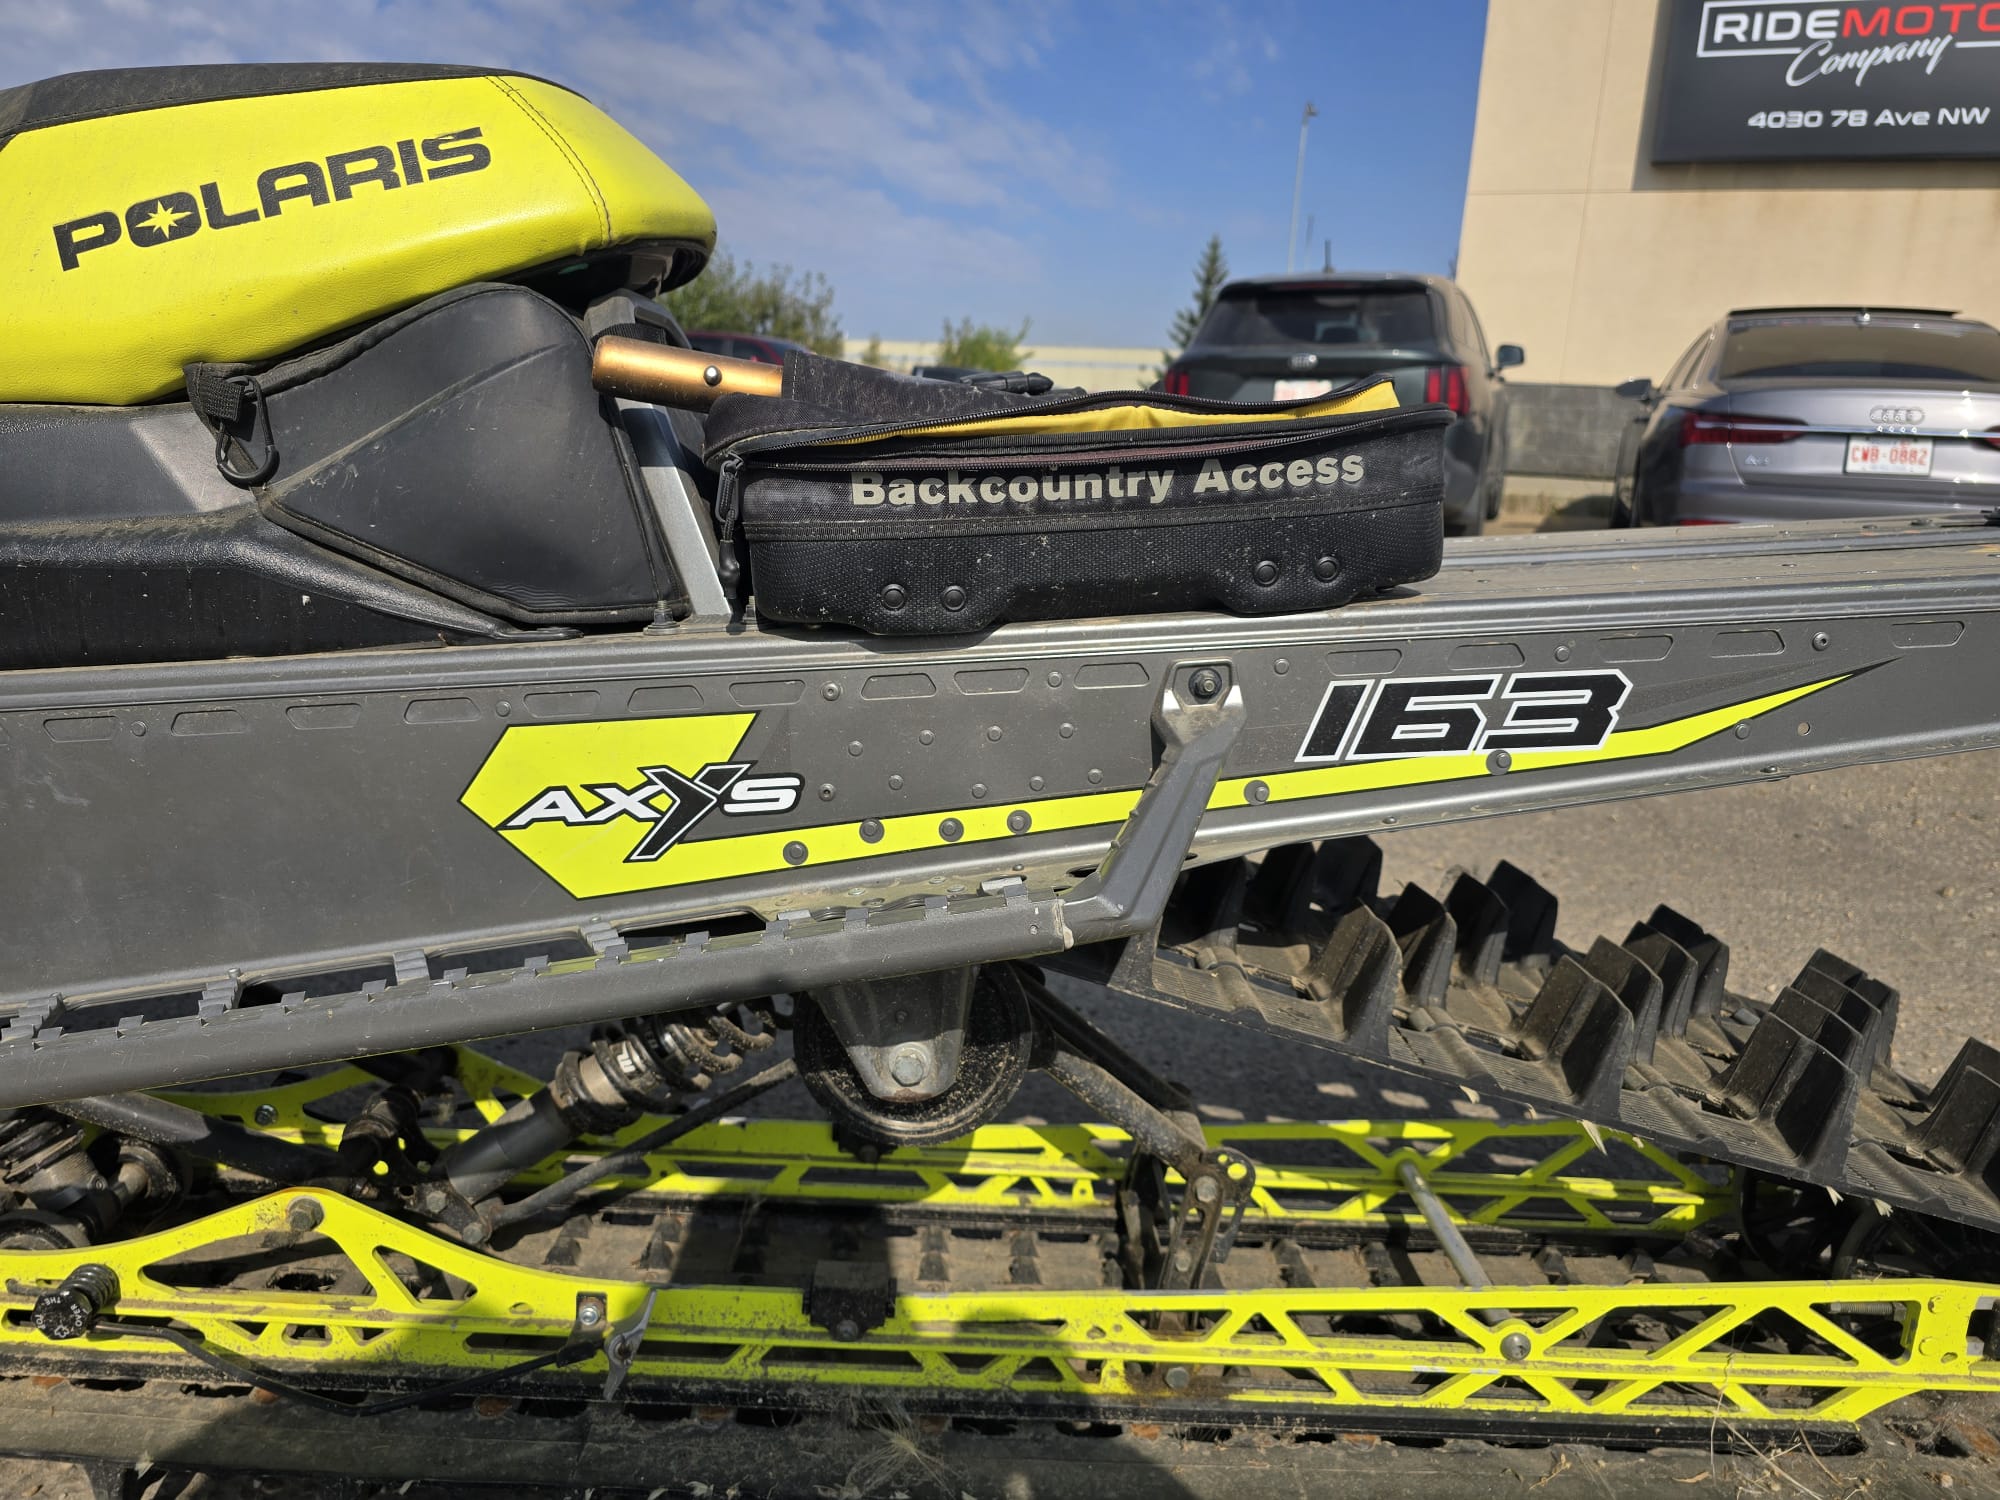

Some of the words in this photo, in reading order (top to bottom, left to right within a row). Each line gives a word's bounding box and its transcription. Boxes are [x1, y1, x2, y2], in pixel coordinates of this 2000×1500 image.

[1785, 34, 1953, 87] Company
[1747, 111, 1823, 128] 4030
[1830, 109, 1868, 127] 78
[1874, 109, 1930, 126] Ave
[1937, 107, 1990, 125] NW
[52, 126, 492, 272] POLARIS
[850, 465, 1175, 505] Backcountry
[1193, 454, 1365, 494] Access
[1296, 668, 1634, 763] 163
[496, 760, 804, 863] AXYS
